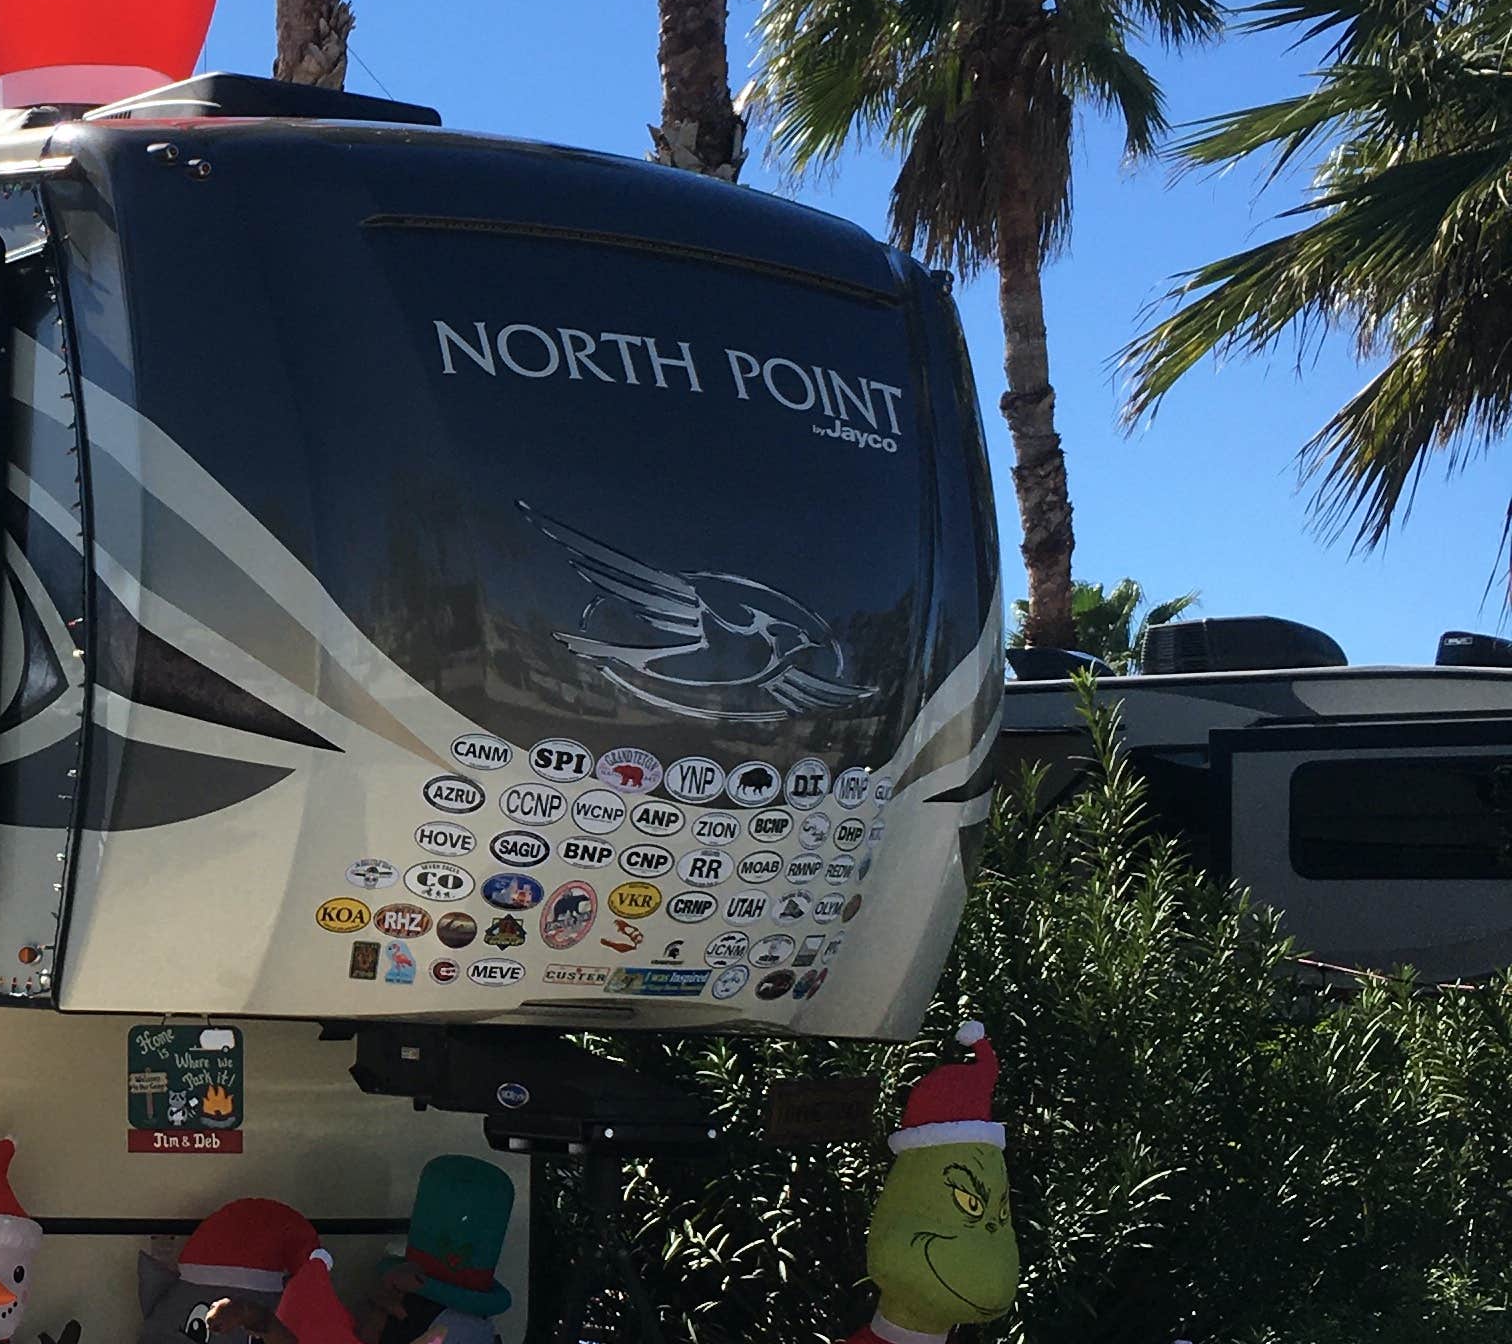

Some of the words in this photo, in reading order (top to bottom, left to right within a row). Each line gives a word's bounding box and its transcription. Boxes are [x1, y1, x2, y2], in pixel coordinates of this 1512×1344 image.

[433, 320, 703, 392] NORTH
[725, 348, 901, 435] POINT
[812, 424, 826, 435] by
[826, 419, 897, 453] Jayco
[454, 741, 508, 762] CANM
[535, 748, 586, 774] SPI
[680, 764, 715, 796] YNP
[433, 786, 476, 805] AZRU
[506, 789, 562, 818] CCNP
[576, 802, 624, 821] WCNP
[636, 808, 680, 828] ANP
[696, 821, 737, 839] ZION
[754, 818, 788, 834] BCNP
[838, 826, 862, 842] DHP
[419, 829, 472, 851] HOVE
[499, 840, 542, 858] SAGU
[564, 842, 613, 864] BNP
[626, 851, 668, 870] CNP
[689, 858, 722, 879] RR
[741, 861, 779, 874] MOAB
[788, 862, 821, 876] RMNP
[825, 864, 854, 878] REDW
[416, 871, 464, 890] CO
[618, 892, 653, 908] VKR
[673, 899, 713, 915] CRNP
[727, 898, 766, 918] UTAH
[322, 907, 366, 924] KOA
[384, 911, 422, 931] RHZ
[707, 944, 746, 956] JCNM
[470, 965, 521, 980] MEVE
[545, 971, 607, 982] CUSTER
[669, 971, 708, 984] Inspired
[136, 1029, 175, 1055] Home
[157, 1048, 170, 1059] is
[174, 1052, 210, 1069] Where
[217, 1058, 233, 1068] we
[182, 1070, 213, 1091] Park
[217, 1070, 235, 1087] it!
[182, 1136, 191, 1147] &
[193, 1133, 220, 1148] Deb
